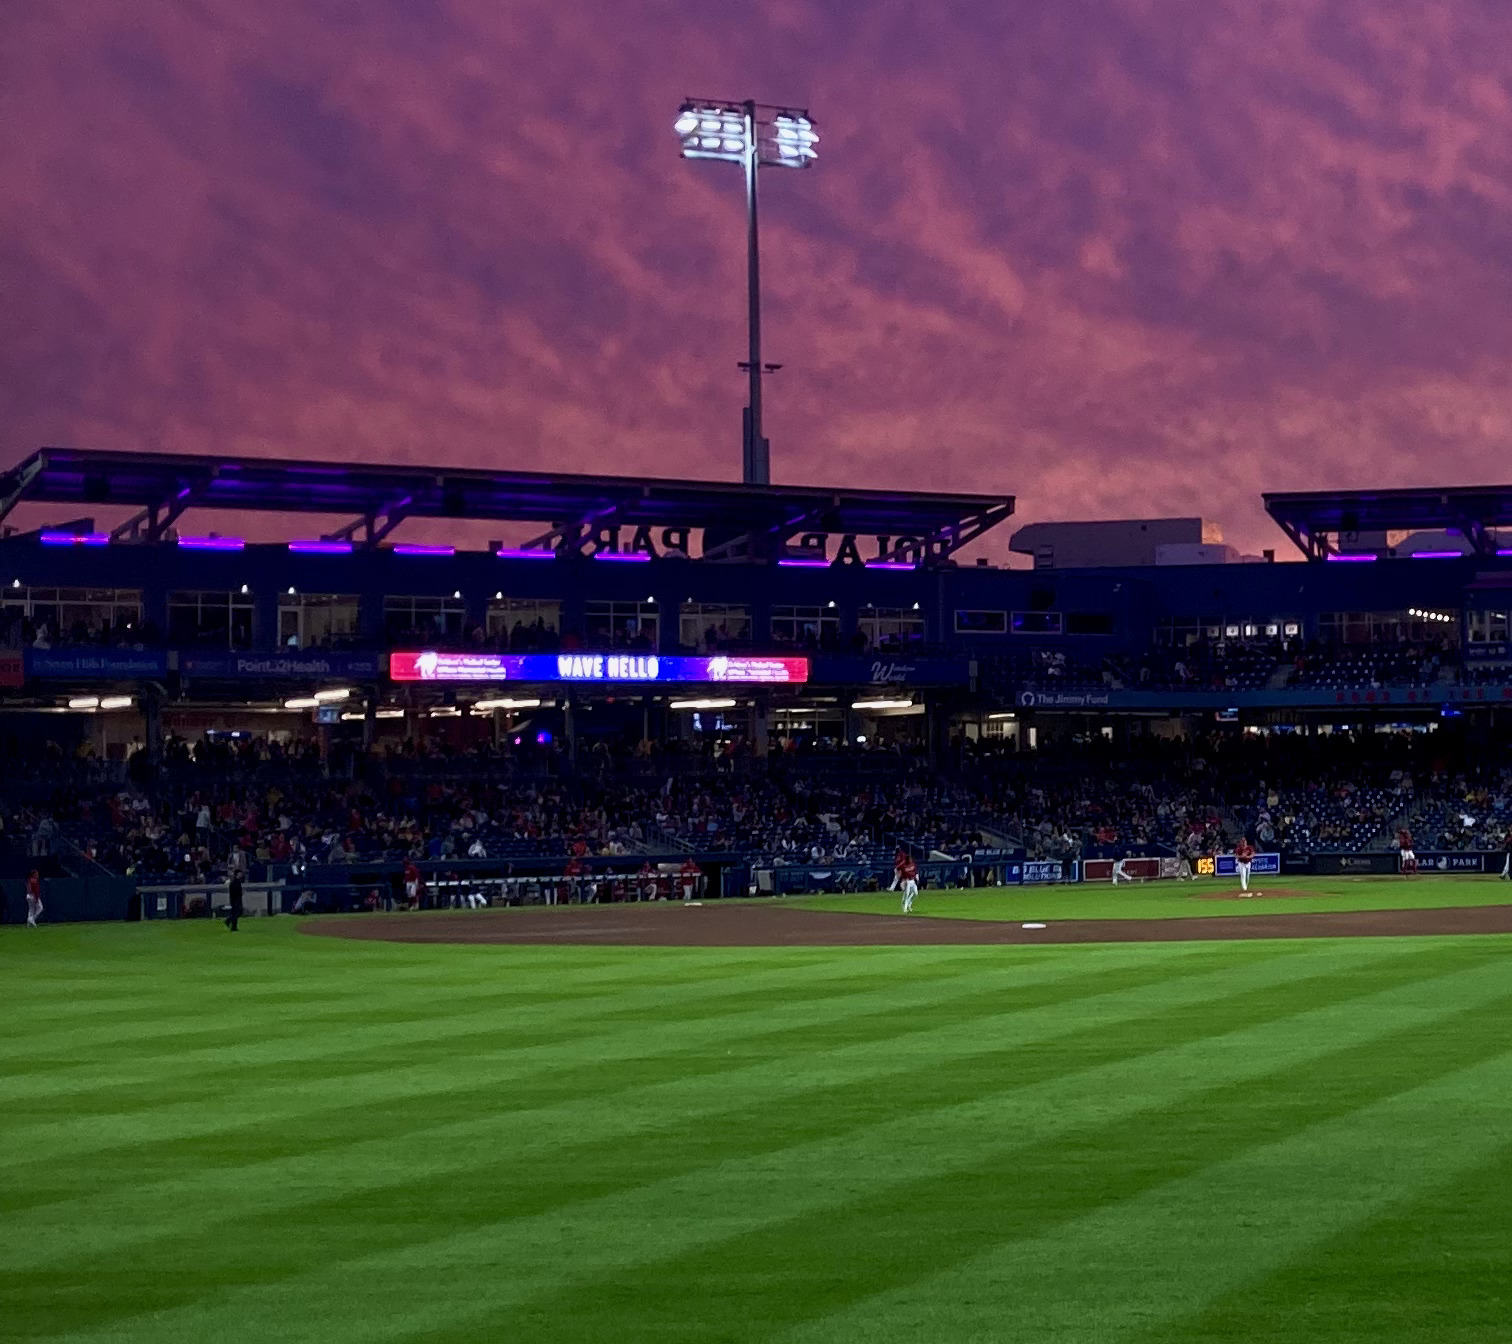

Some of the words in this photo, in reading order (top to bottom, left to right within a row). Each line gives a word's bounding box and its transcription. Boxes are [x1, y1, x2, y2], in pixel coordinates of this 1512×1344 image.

[558, 656, 604, 678] WAVE
[607, 656, 659, 678] HELLO
[1037, 694, 1054, 704] The
[1086, 694, 1109, 704] Fund
